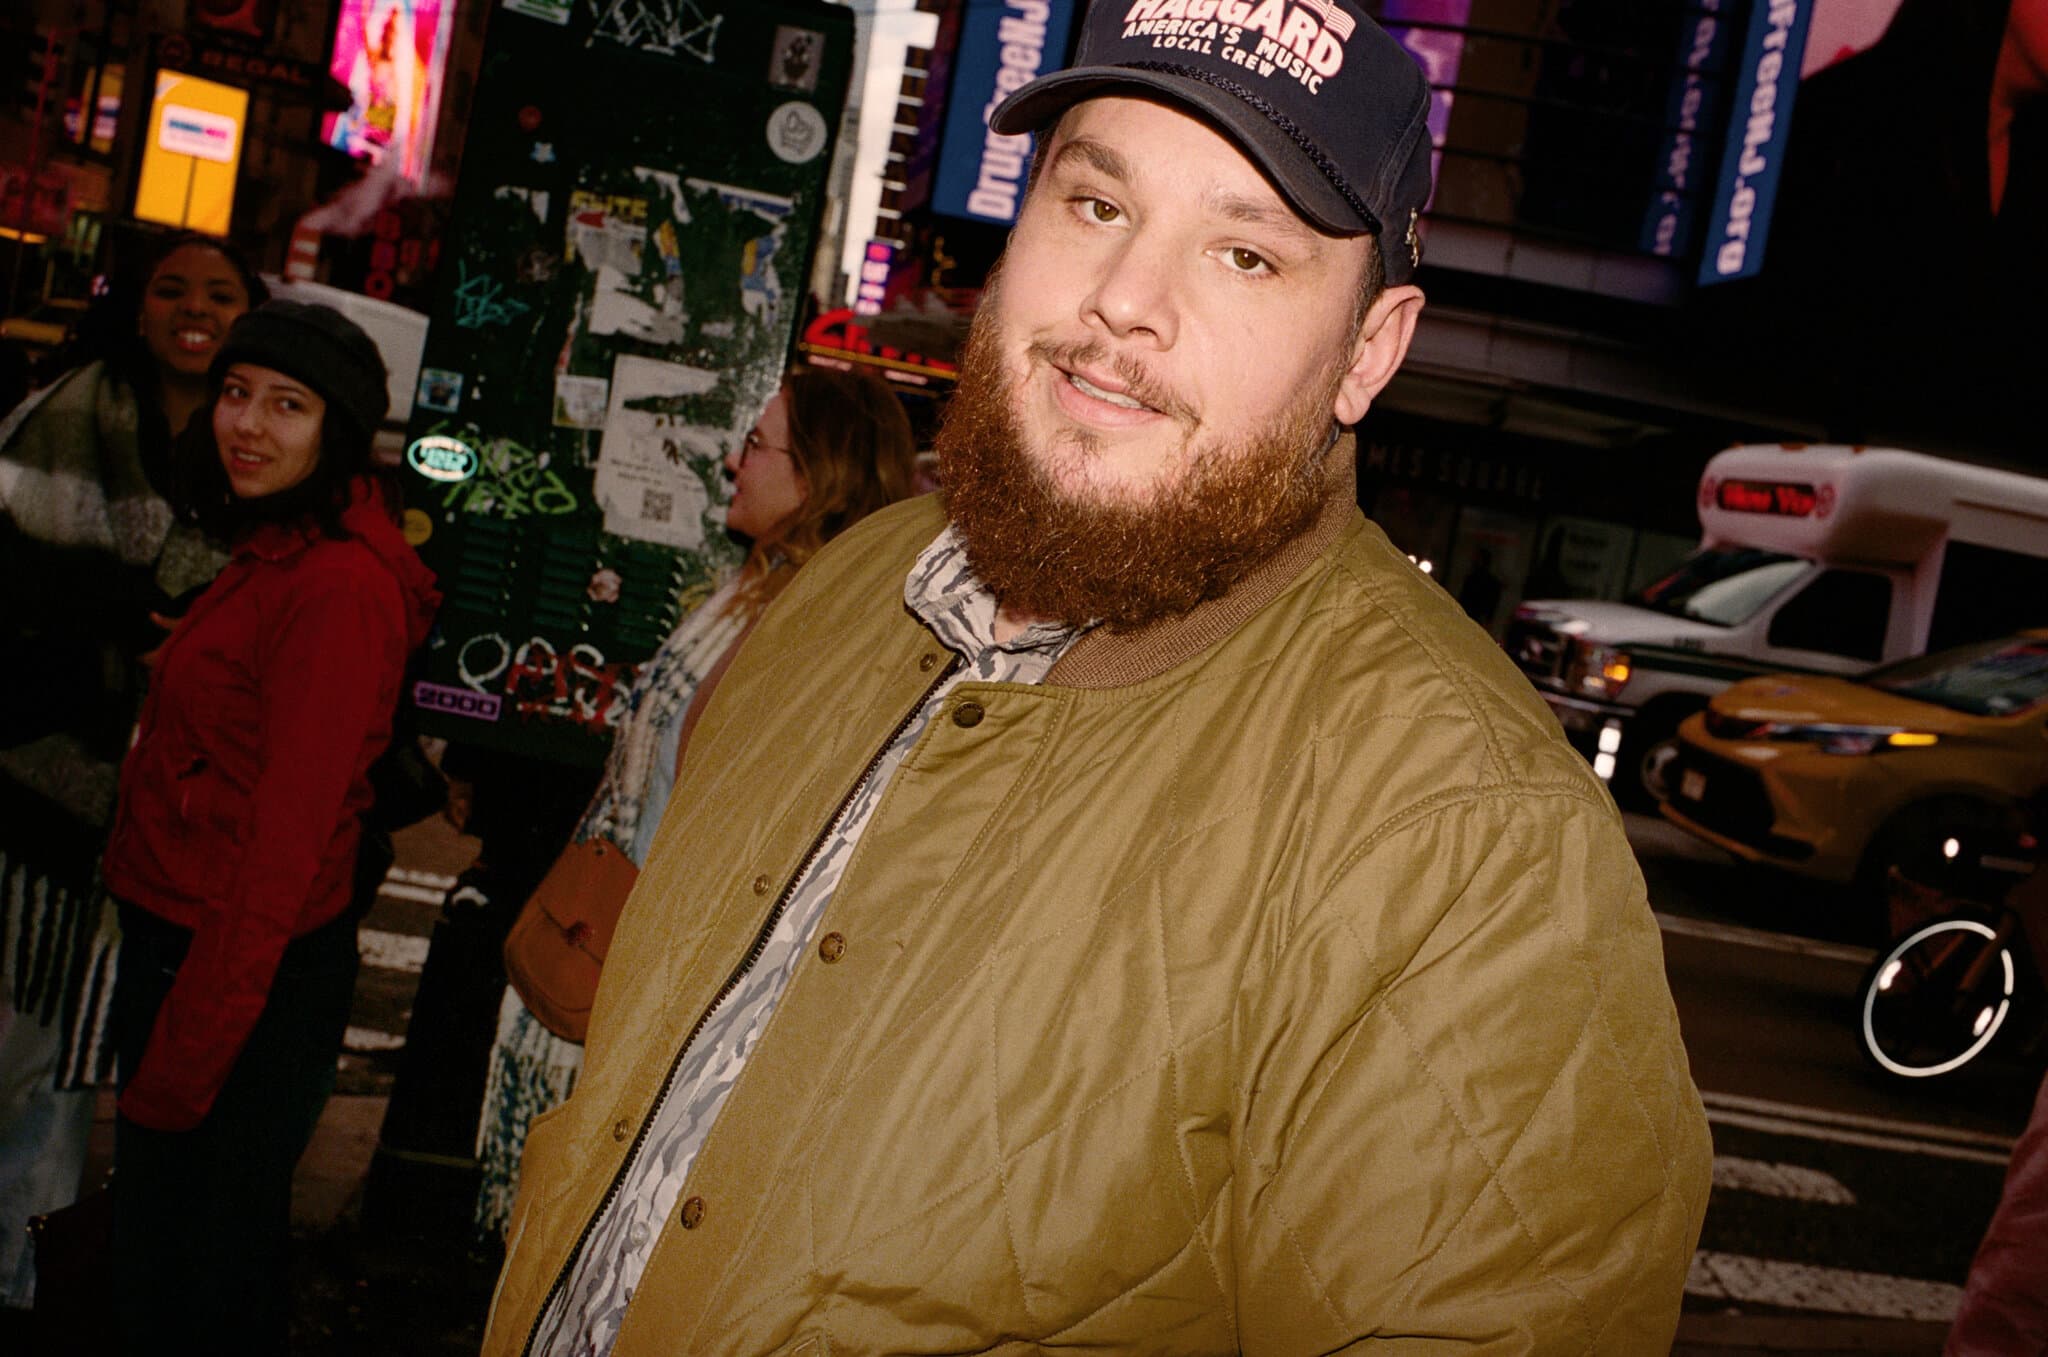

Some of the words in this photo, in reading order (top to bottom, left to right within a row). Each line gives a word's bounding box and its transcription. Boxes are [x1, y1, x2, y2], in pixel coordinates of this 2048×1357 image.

[1121, 19, 1243, 45] AMERICA'S
[1255, 36, 1323, 95] MUSIC
[1124, 0, 1343, 78] HAGGARD
[1152, 36, 1212, 55] LOCAL
[1221, 46, 1277, 78] CREW
[966, 0, 1051, 221] DrugeeNJ
